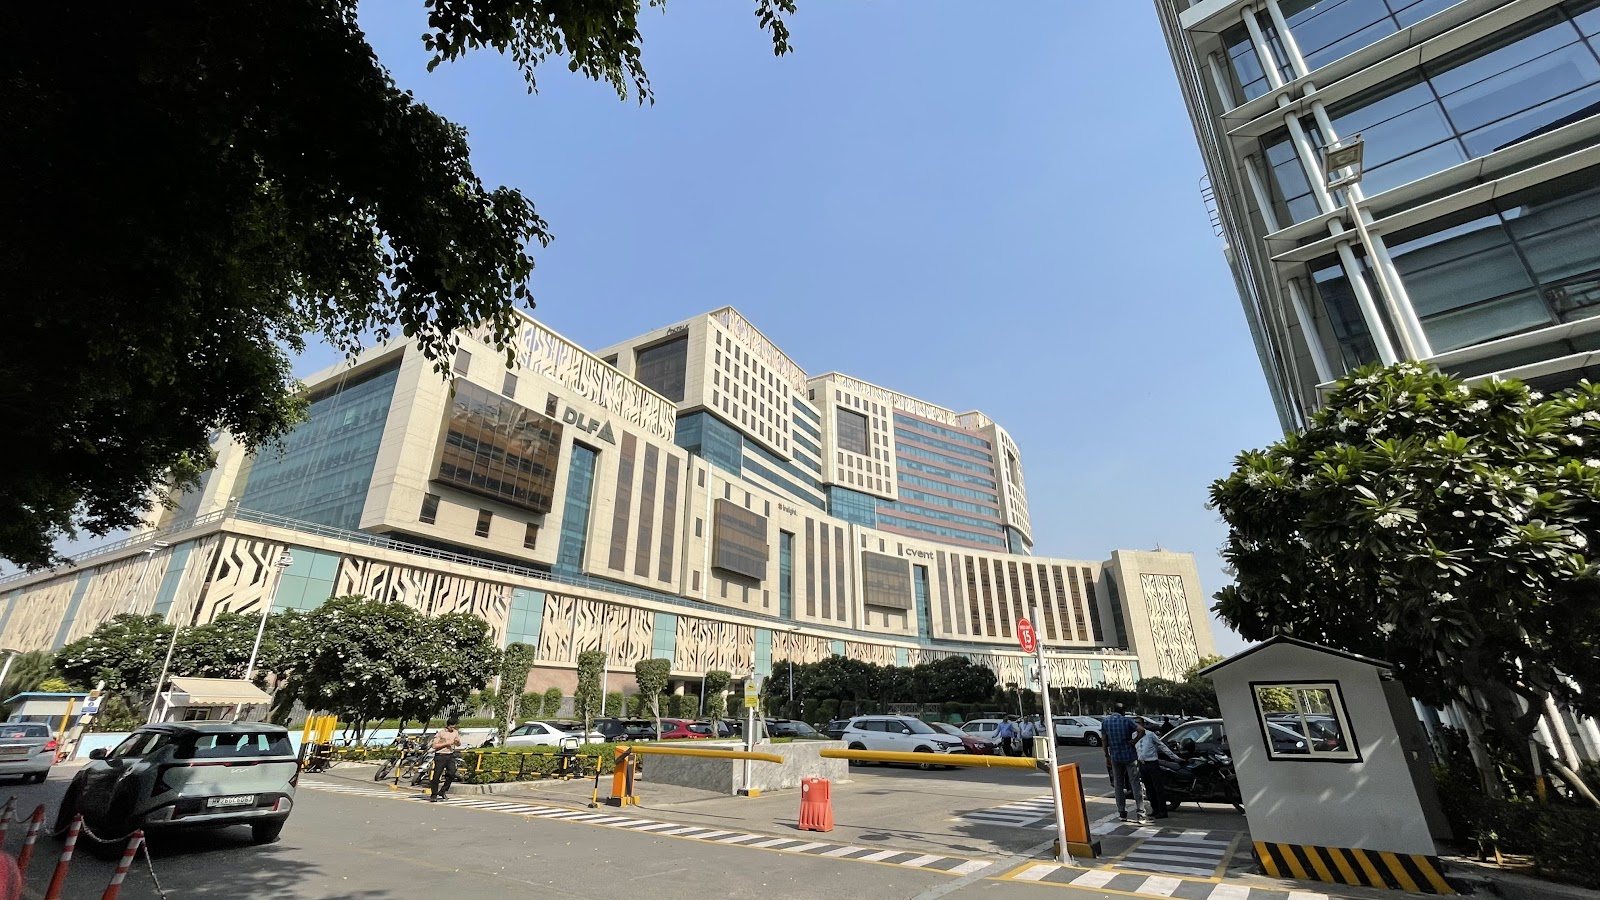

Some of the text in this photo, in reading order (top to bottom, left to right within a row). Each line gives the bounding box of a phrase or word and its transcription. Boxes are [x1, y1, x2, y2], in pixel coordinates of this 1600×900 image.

[563, 406, 600, 434] DLF
[905, 548, 934, 560] cvent
[1022, 630, 1032, 643] 15
